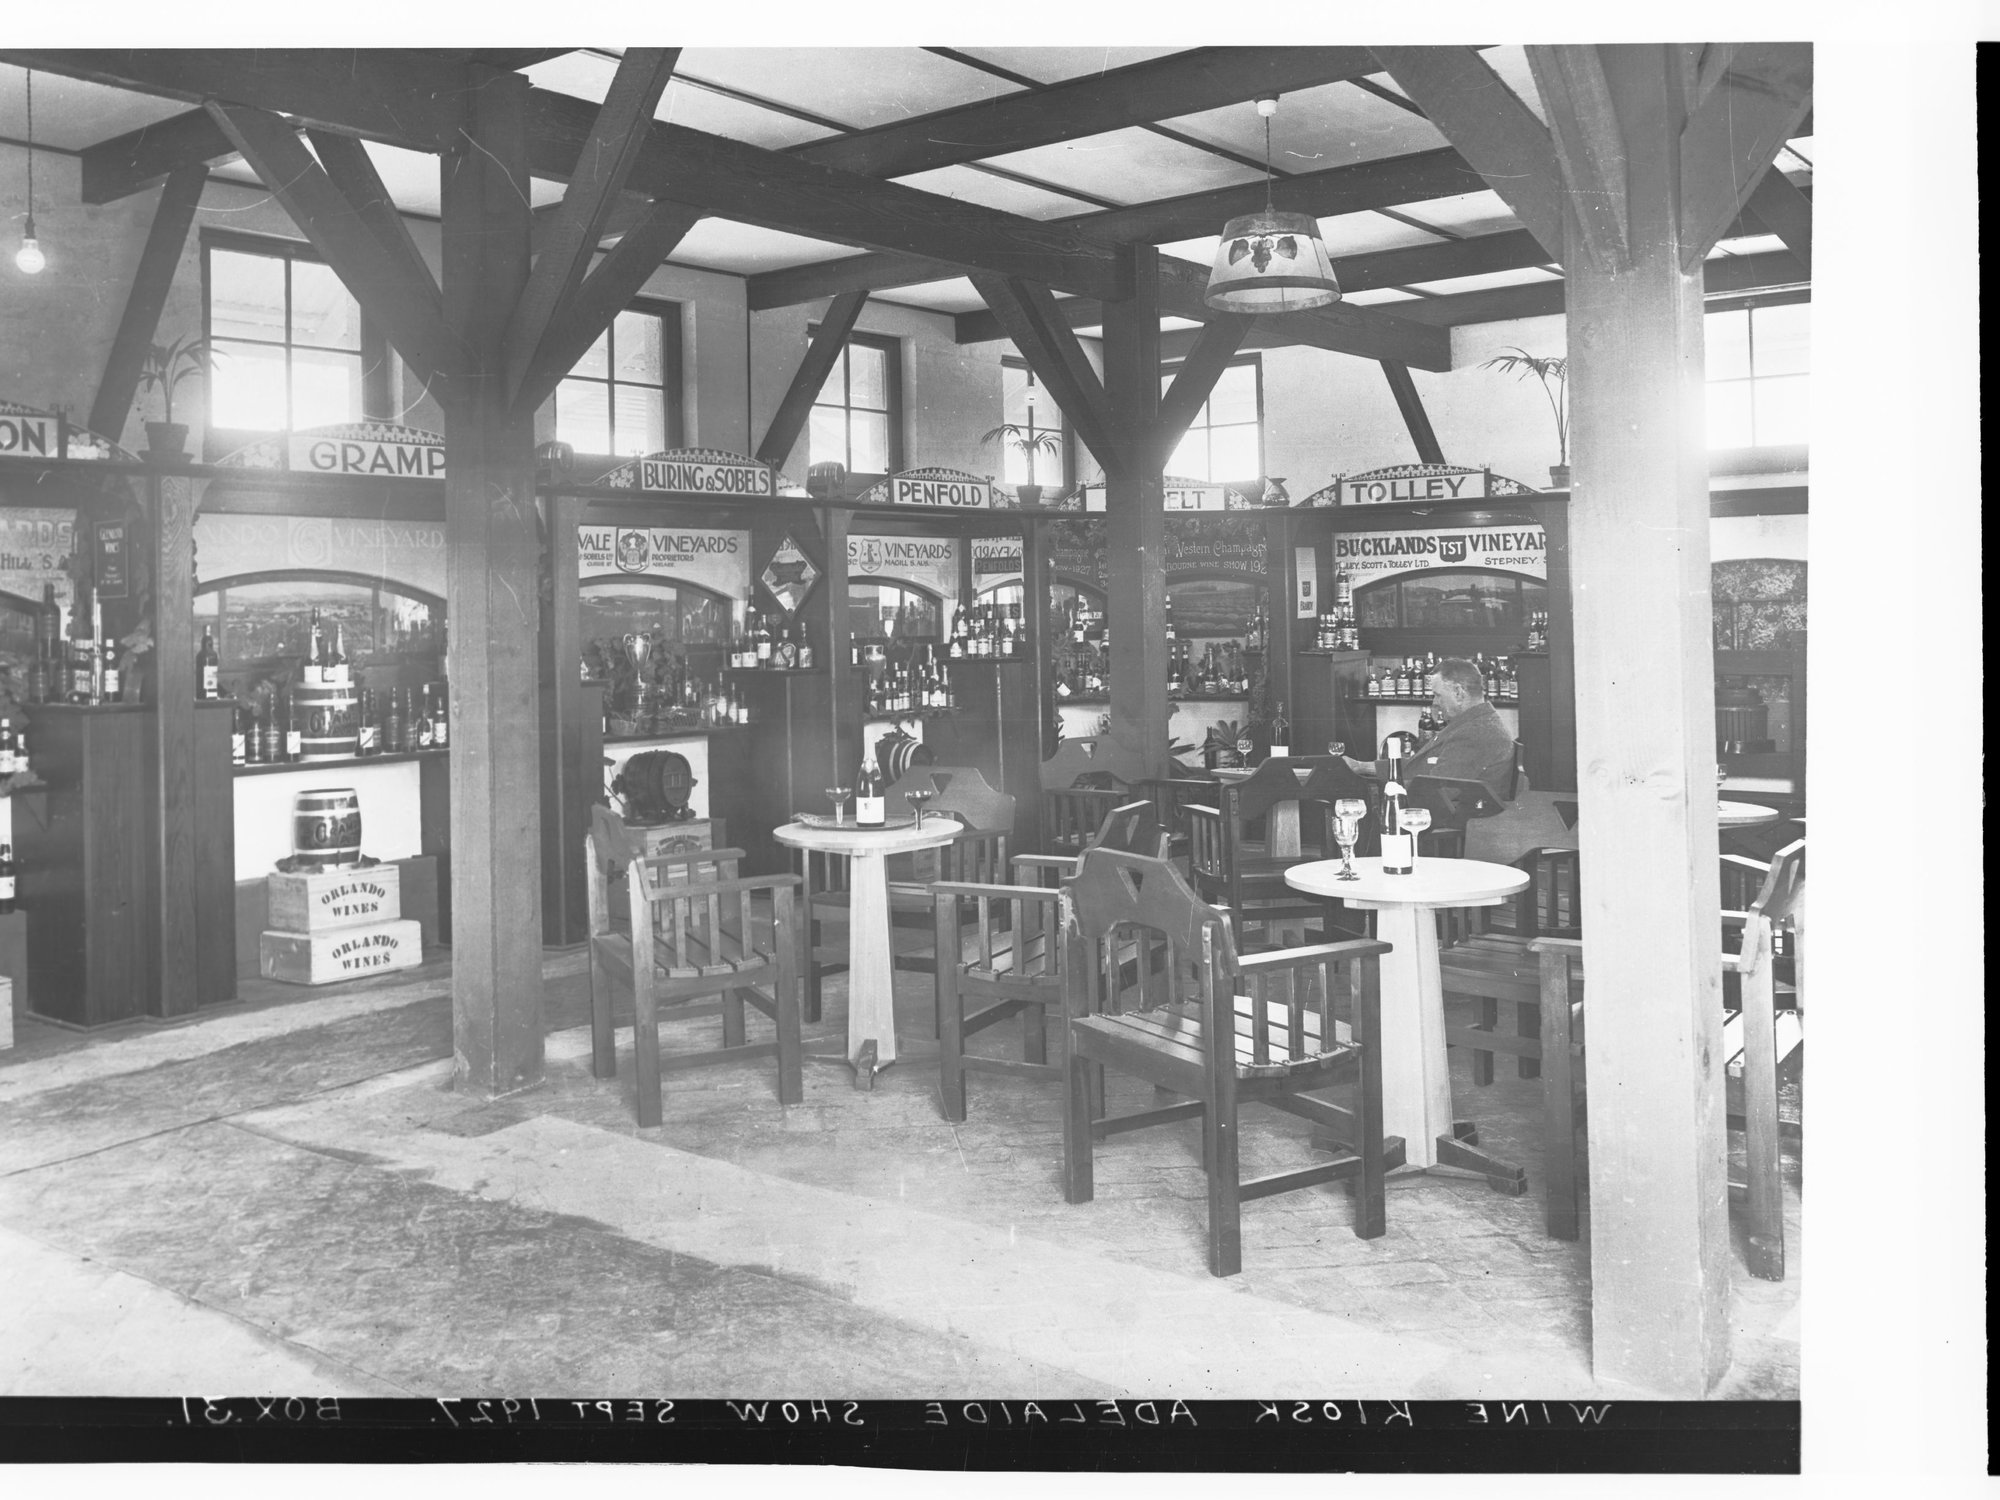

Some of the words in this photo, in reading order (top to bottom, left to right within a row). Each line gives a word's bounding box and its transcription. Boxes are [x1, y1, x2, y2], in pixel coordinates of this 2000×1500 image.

[308, 440, 446, 475] GRAMP
[643, 462, 703, 491] BURING
[714, 467, 769, 494] SOBELS
[1350, 476, 1466, 503] TOLLEY
[898, 480, 982, 506] PENFOLD
[578, 533, 611, 551] VALE
[652, 534, 738, 554] VINEYARDS
[884, 542, 952, 560] VINEYARDS
[1336, 535, 1437, 558] BUCKLANDS
[1440, 541, 1463, 556] TST
[321, 882, 386, 905] ORLANDO
[332, 901, 378, 917] WINES
[332, 934, 398, 960] ORLANDO
[342, 951, 391, 970] WINES
